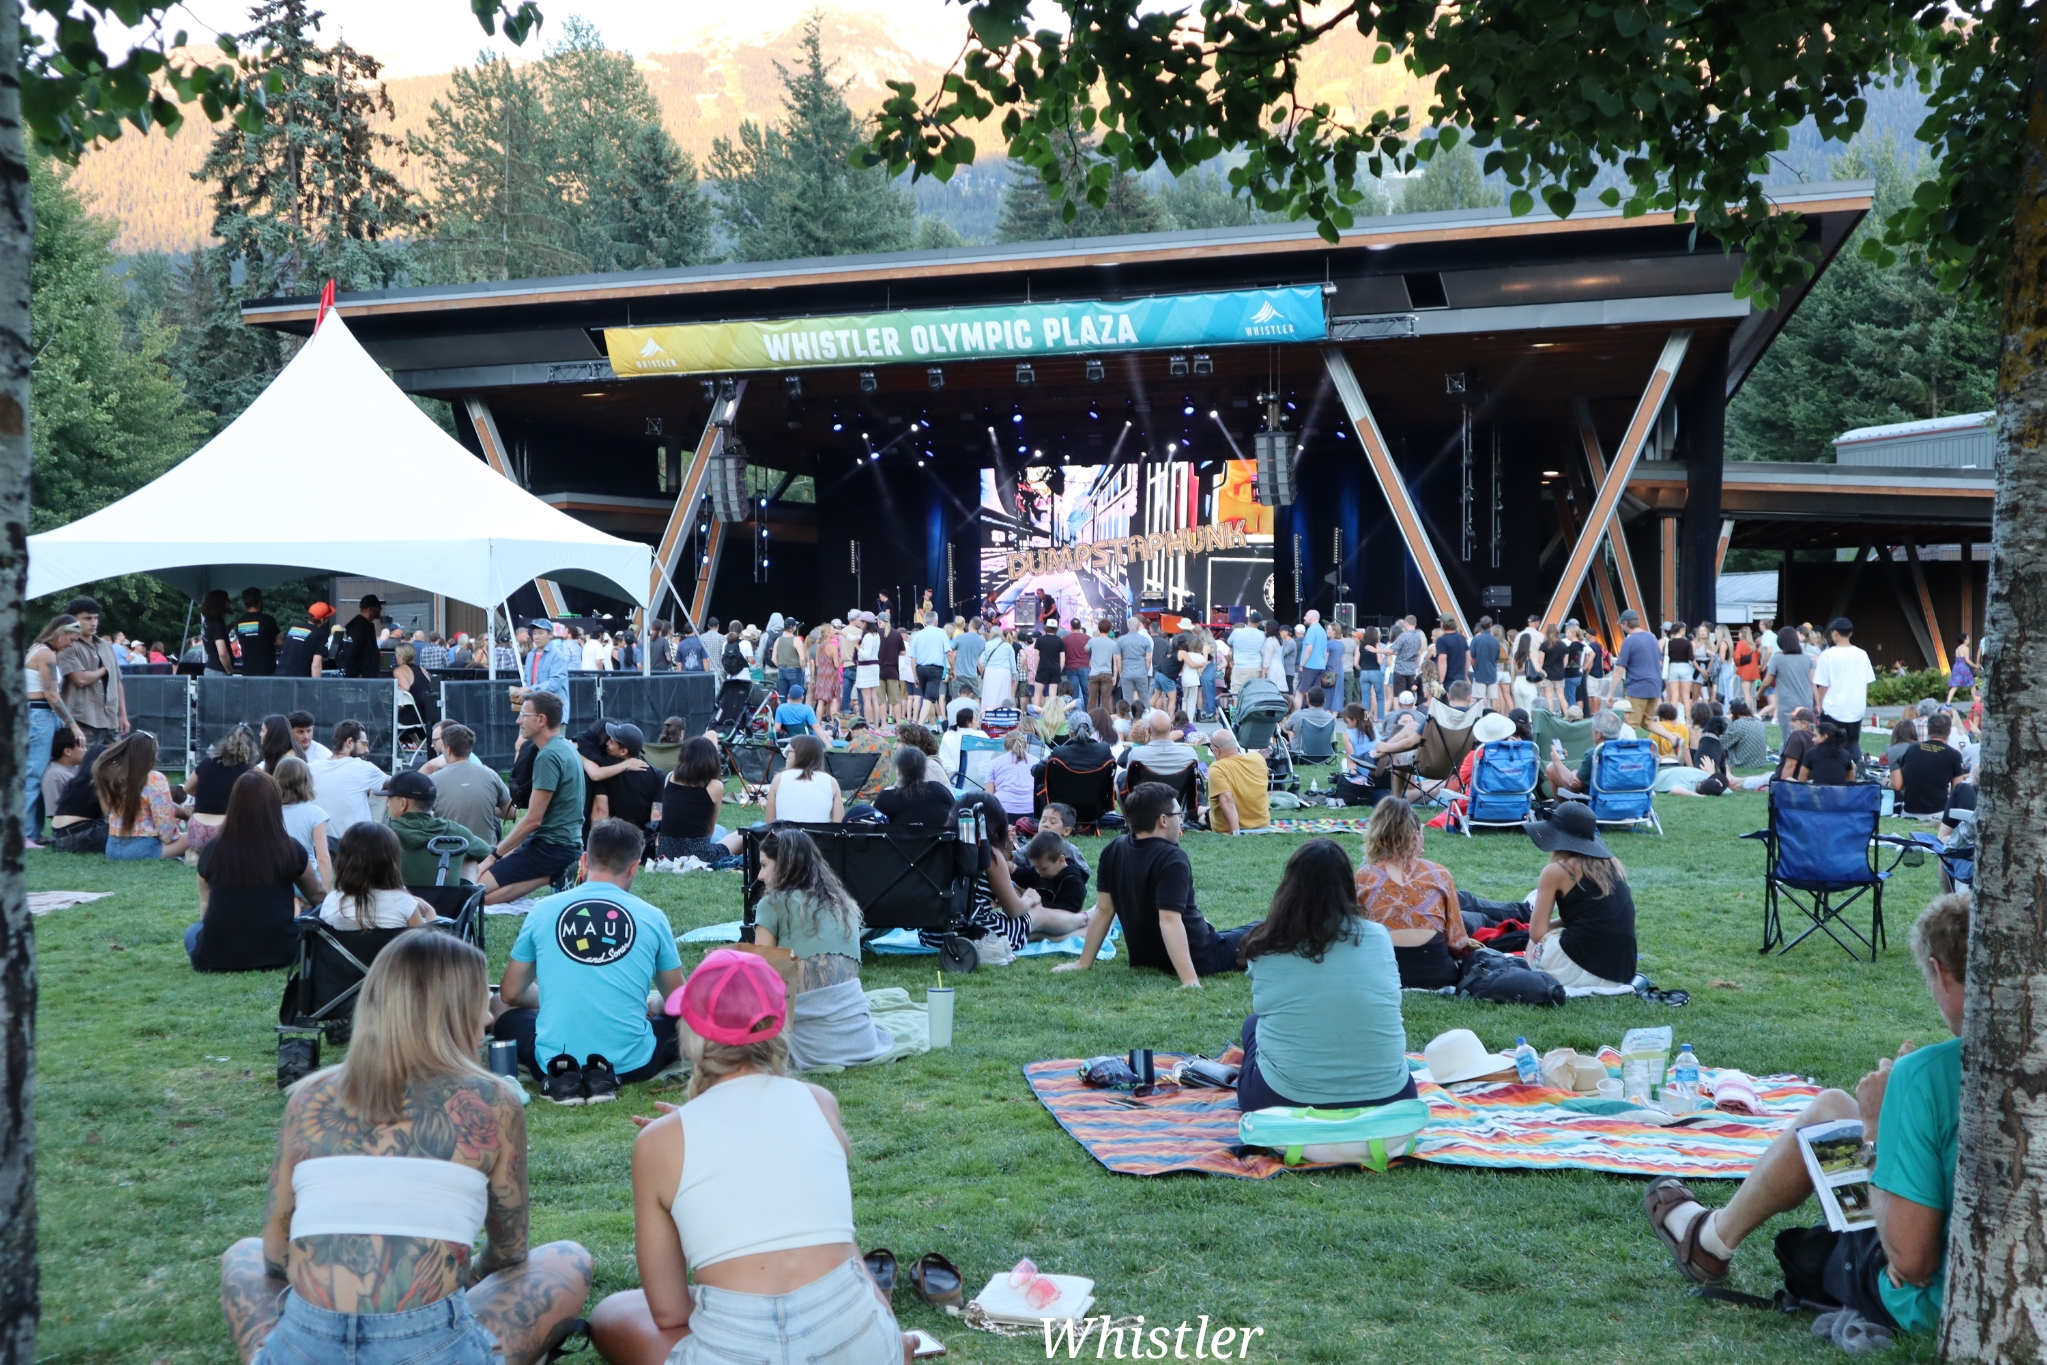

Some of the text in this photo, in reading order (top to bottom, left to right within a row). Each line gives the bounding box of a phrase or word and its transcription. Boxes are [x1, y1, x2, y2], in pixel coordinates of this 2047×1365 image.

[762, 313, 1139, 361] WHISTLER OLYMPIC PLAZA
[1245, 323, 1295, 337] WHISTLER
[635, 358, 678, 369] WHISTLER
[1007, 519, 1248, 580] DUMPSTAPHUNK
[562, 921, 629, 938] MAUI
[585, 952, 606, 964] and
